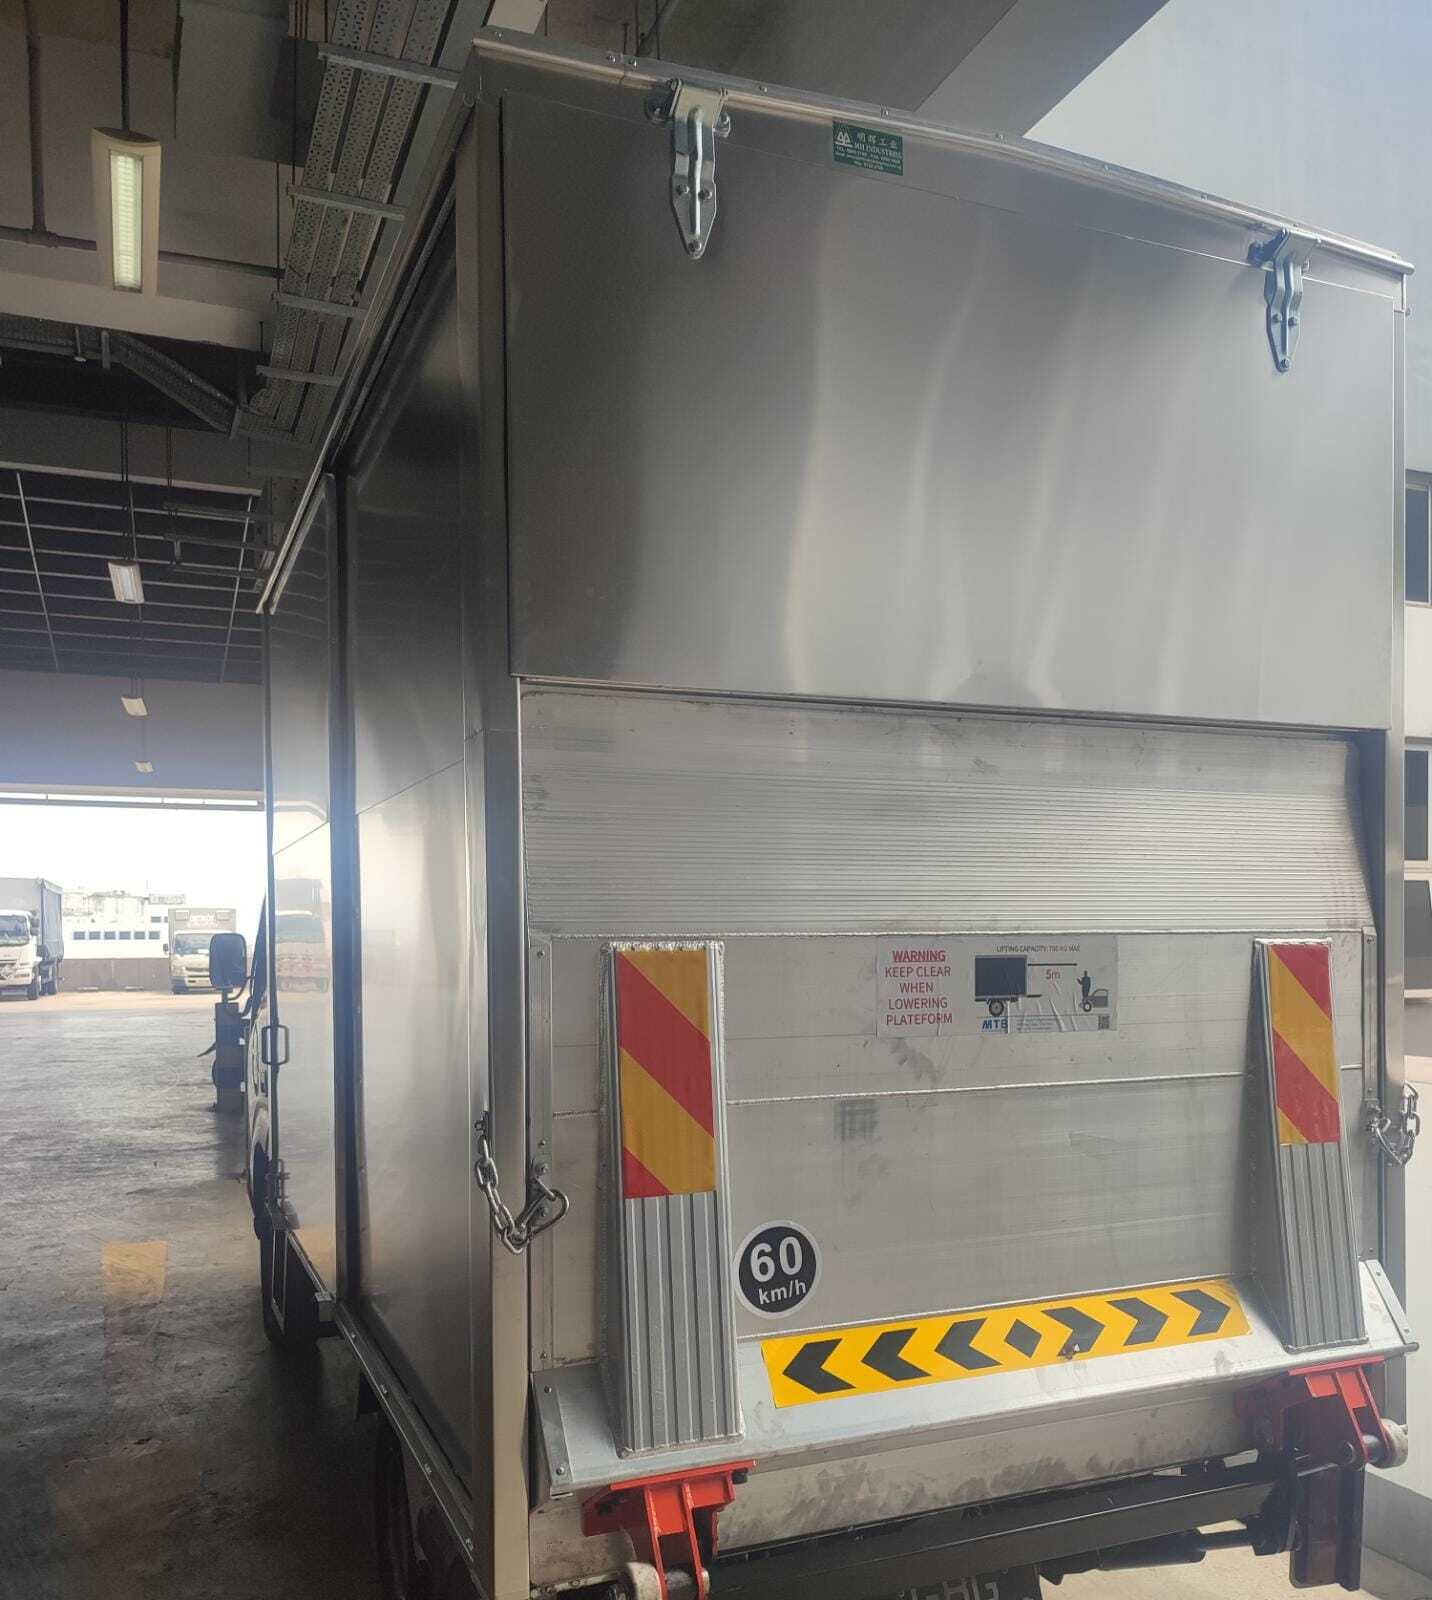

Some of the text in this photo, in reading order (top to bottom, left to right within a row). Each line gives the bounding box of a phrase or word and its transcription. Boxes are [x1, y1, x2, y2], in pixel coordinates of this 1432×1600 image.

[892, 950, 946, 962] WARNING
[885, 966, 951, 978] KEEP CLEAR
[1046, 969, 1061, 980] 5m
[899, 982, 934, 993] WHEN
[888, 997, 948, 1010] LOWERING
[886, 1012, 953, 1026] PLATEFORM
[982, 1019, 1008, 1030] MTB
[750, 1236, 803, 1283] 60
[758, 1279, 806, 1305] km/h
